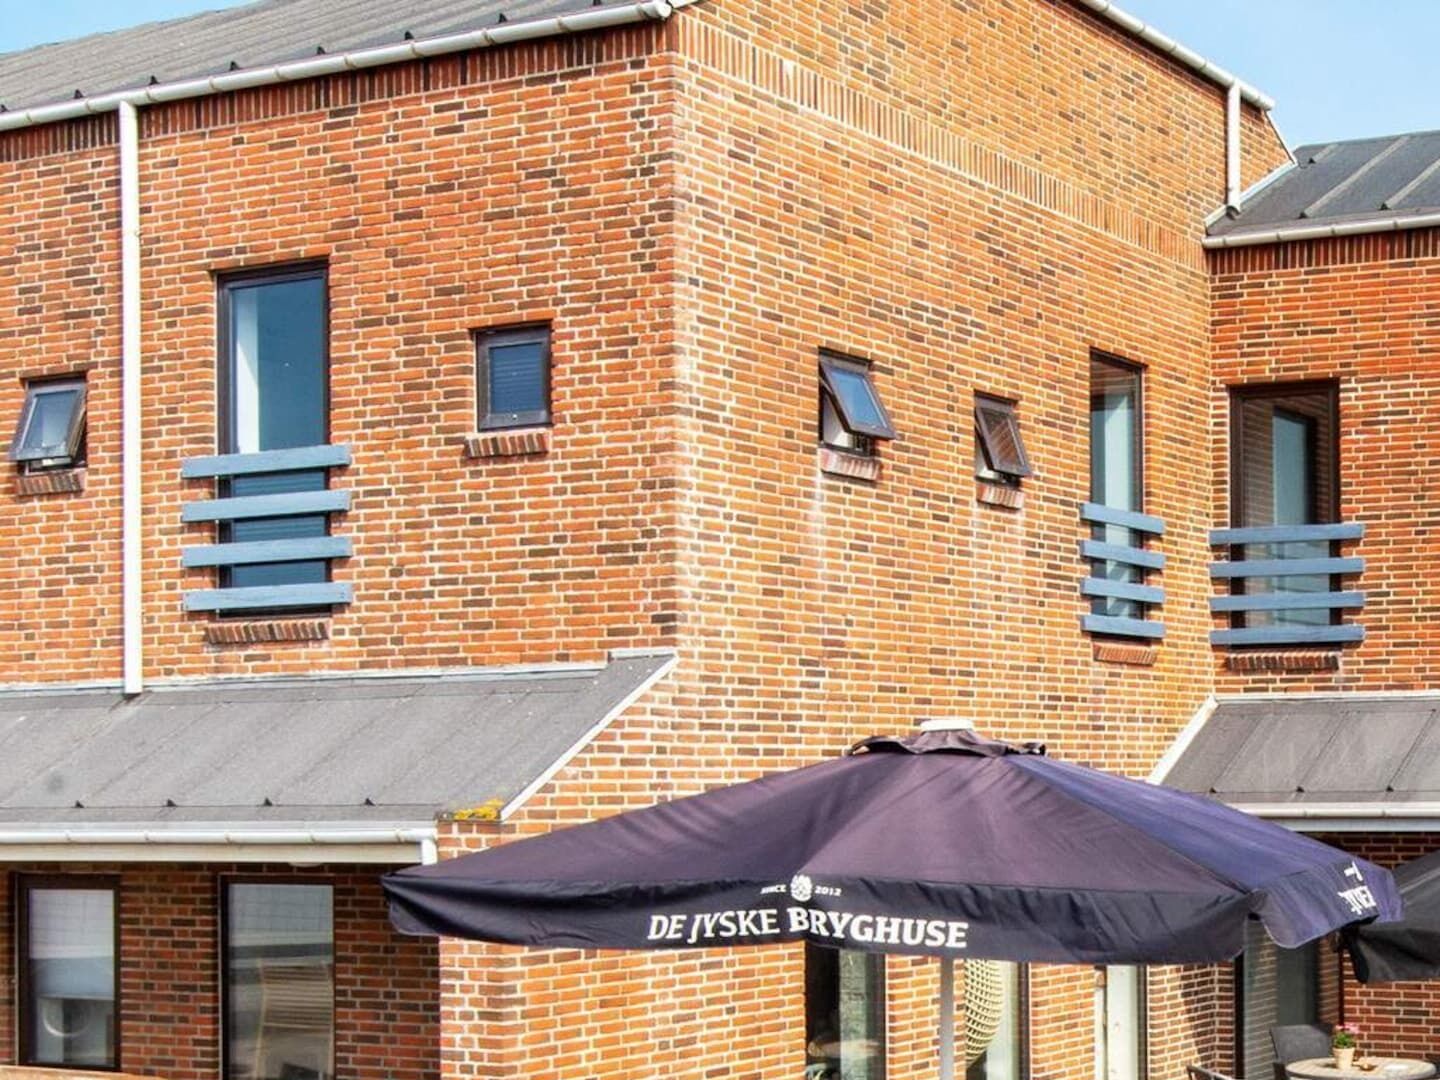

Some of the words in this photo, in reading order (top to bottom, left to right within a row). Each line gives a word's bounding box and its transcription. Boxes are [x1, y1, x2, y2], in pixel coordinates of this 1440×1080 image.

[647, 914, 687, 940] DE
[687, 909, 781, 944] JYSKE
[786, 906, 969, 948] BRYGHUSE
